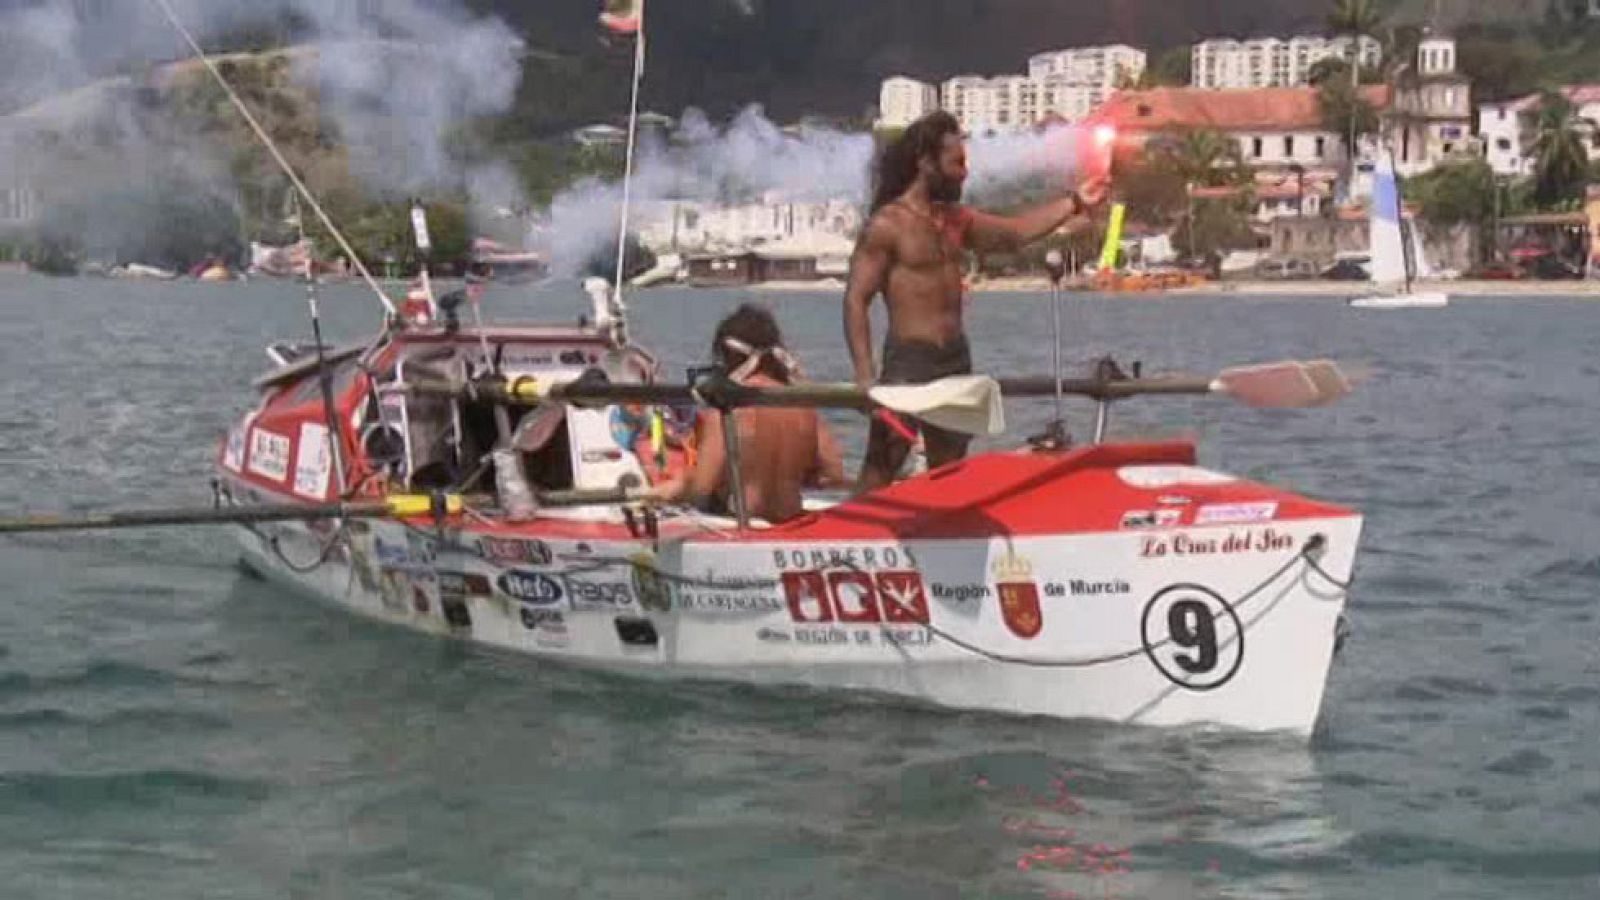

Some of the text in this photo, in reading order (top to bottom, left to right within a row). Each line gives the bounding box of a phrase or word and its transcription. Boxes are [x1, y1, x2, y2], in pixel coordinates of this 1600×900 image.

[1139, 535, 1167, 557] La
[1222, 530, 1251, 553] del
[773, 547, 918, 569] BOMBEROS
[931, 578, 1131, 601] Región de Murcia
[1168, 600, 1218, 674] 9
